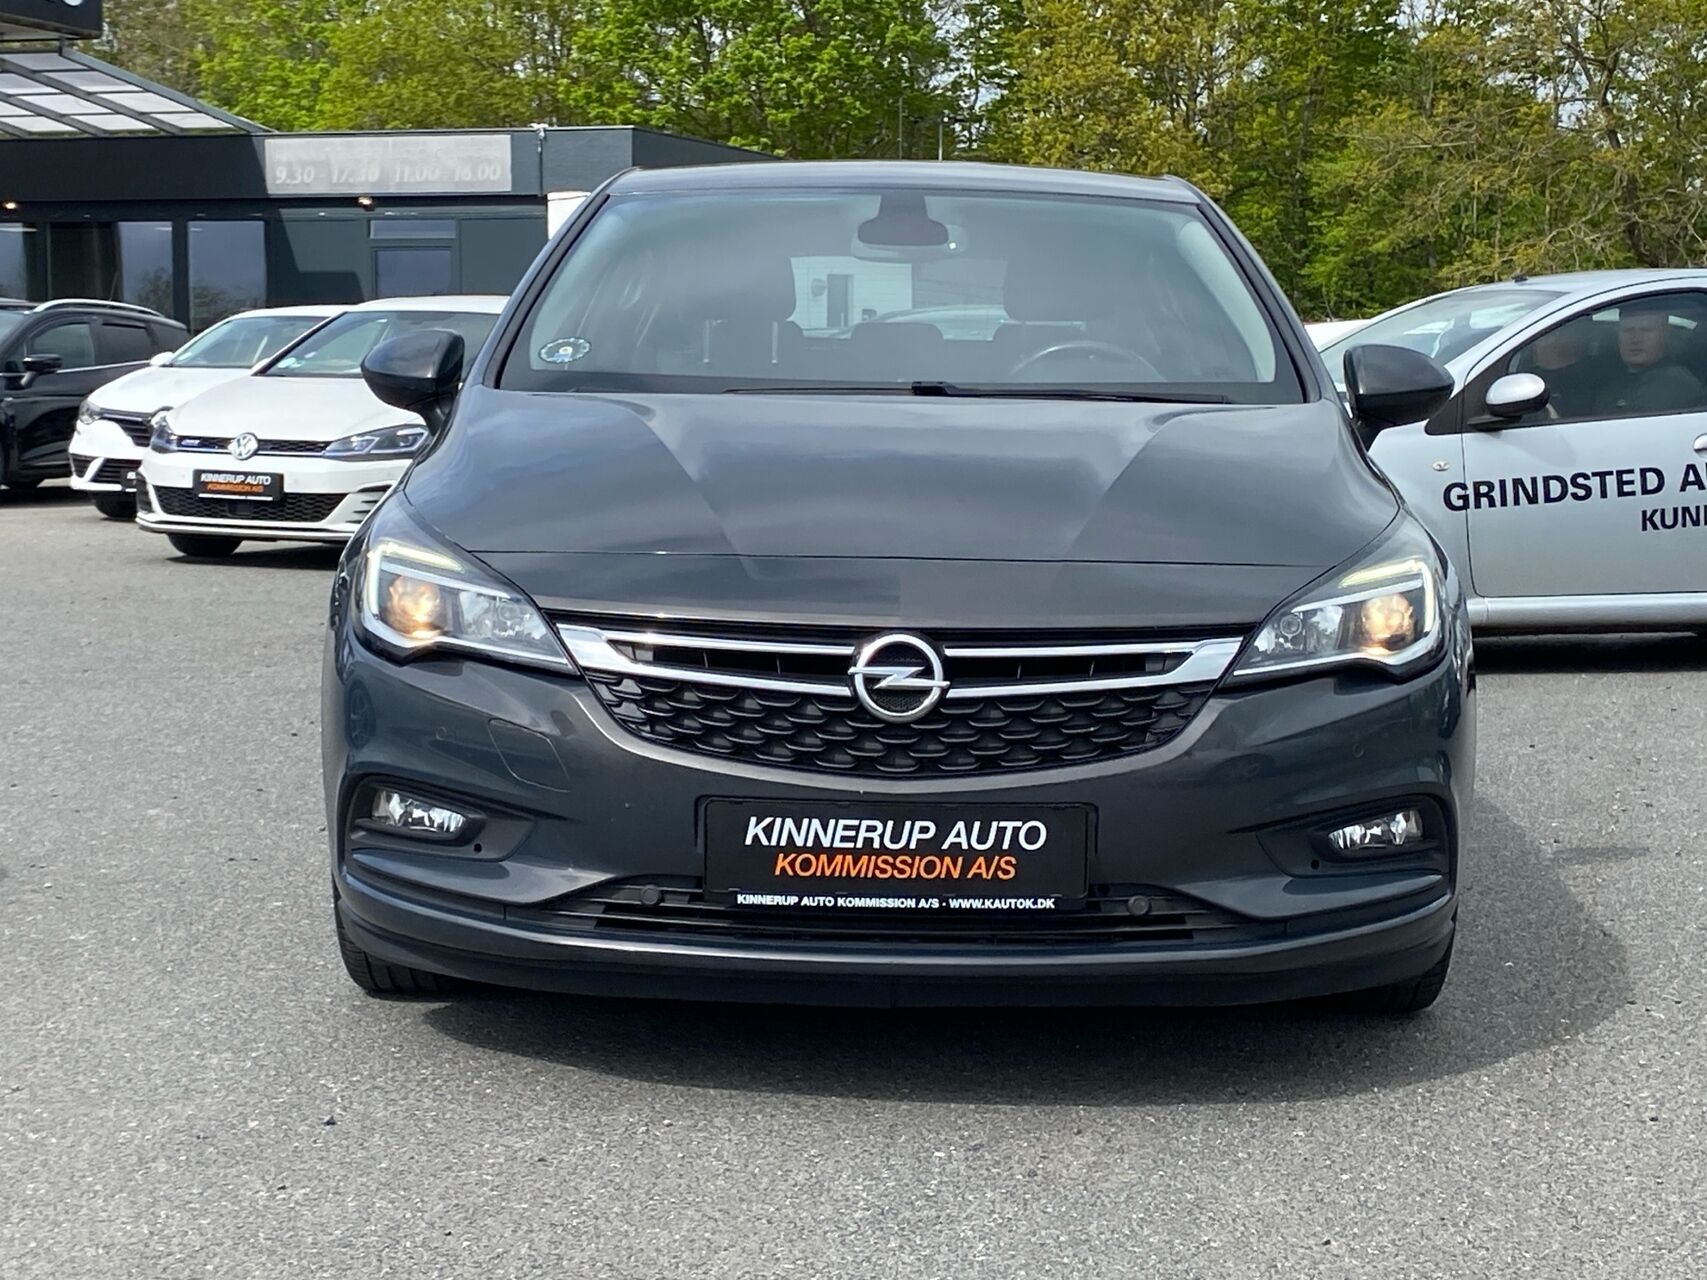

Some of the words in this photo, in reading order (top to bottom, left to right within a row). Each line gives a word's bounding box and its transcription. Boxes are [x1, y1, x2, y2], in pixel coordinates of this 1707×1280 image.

[275, 165, 314, 184] 9.30
[245, 475, 271, 485] AUTO
[1442, 467, 1665, 511] GRINDSTED
[1679, 462, 1707, 492] A
[1641, 504, 1707, 531] KUN
[744, 816, 936, 850] KINNERUP
[941, 820, 1047, 851] AUTO
[774, 853, 963, 879] KOMMISSION
[966, 855, 1017, 880] A/S
[737, 894, 799, 906] KINNERUP
[801, 897, 835, 907] AUTO
[837, 897, 916, 908] KOMMISSION
[918, 898, 940, 908] A/S
[949, 898, 1055, 909] WWW.KAUTOK.DK
